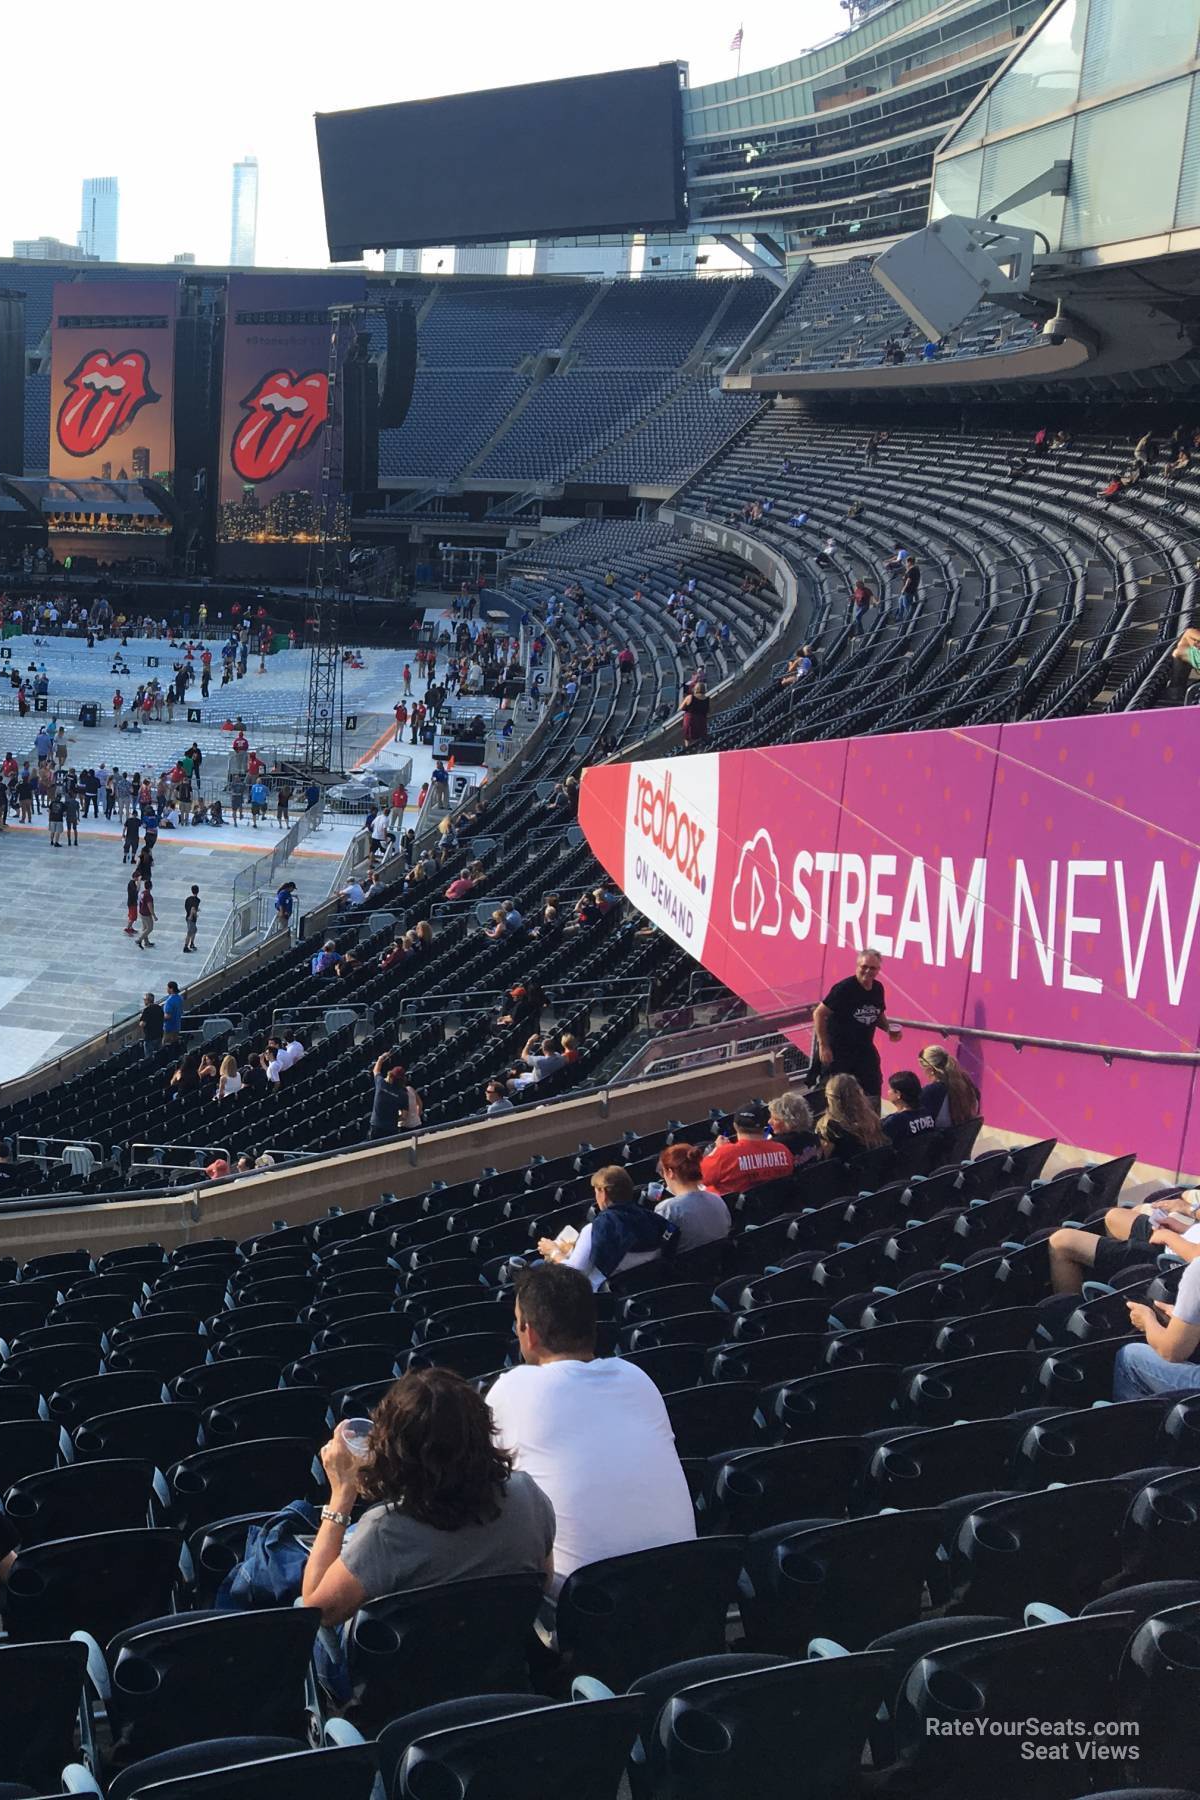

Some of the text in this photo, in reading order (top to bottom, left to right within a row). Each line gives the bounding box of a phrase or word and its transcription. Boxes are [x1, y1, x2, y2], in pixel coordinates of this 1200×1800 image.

[535, 672, 545, 685] 6
[190, 711, 198, 721] A
[635, 855, 694, 939] ON DEMAND
[789, 850, 1200, 1006] STREAM NEW
[738, 1151, 789, 1171] MILWAUKEE
